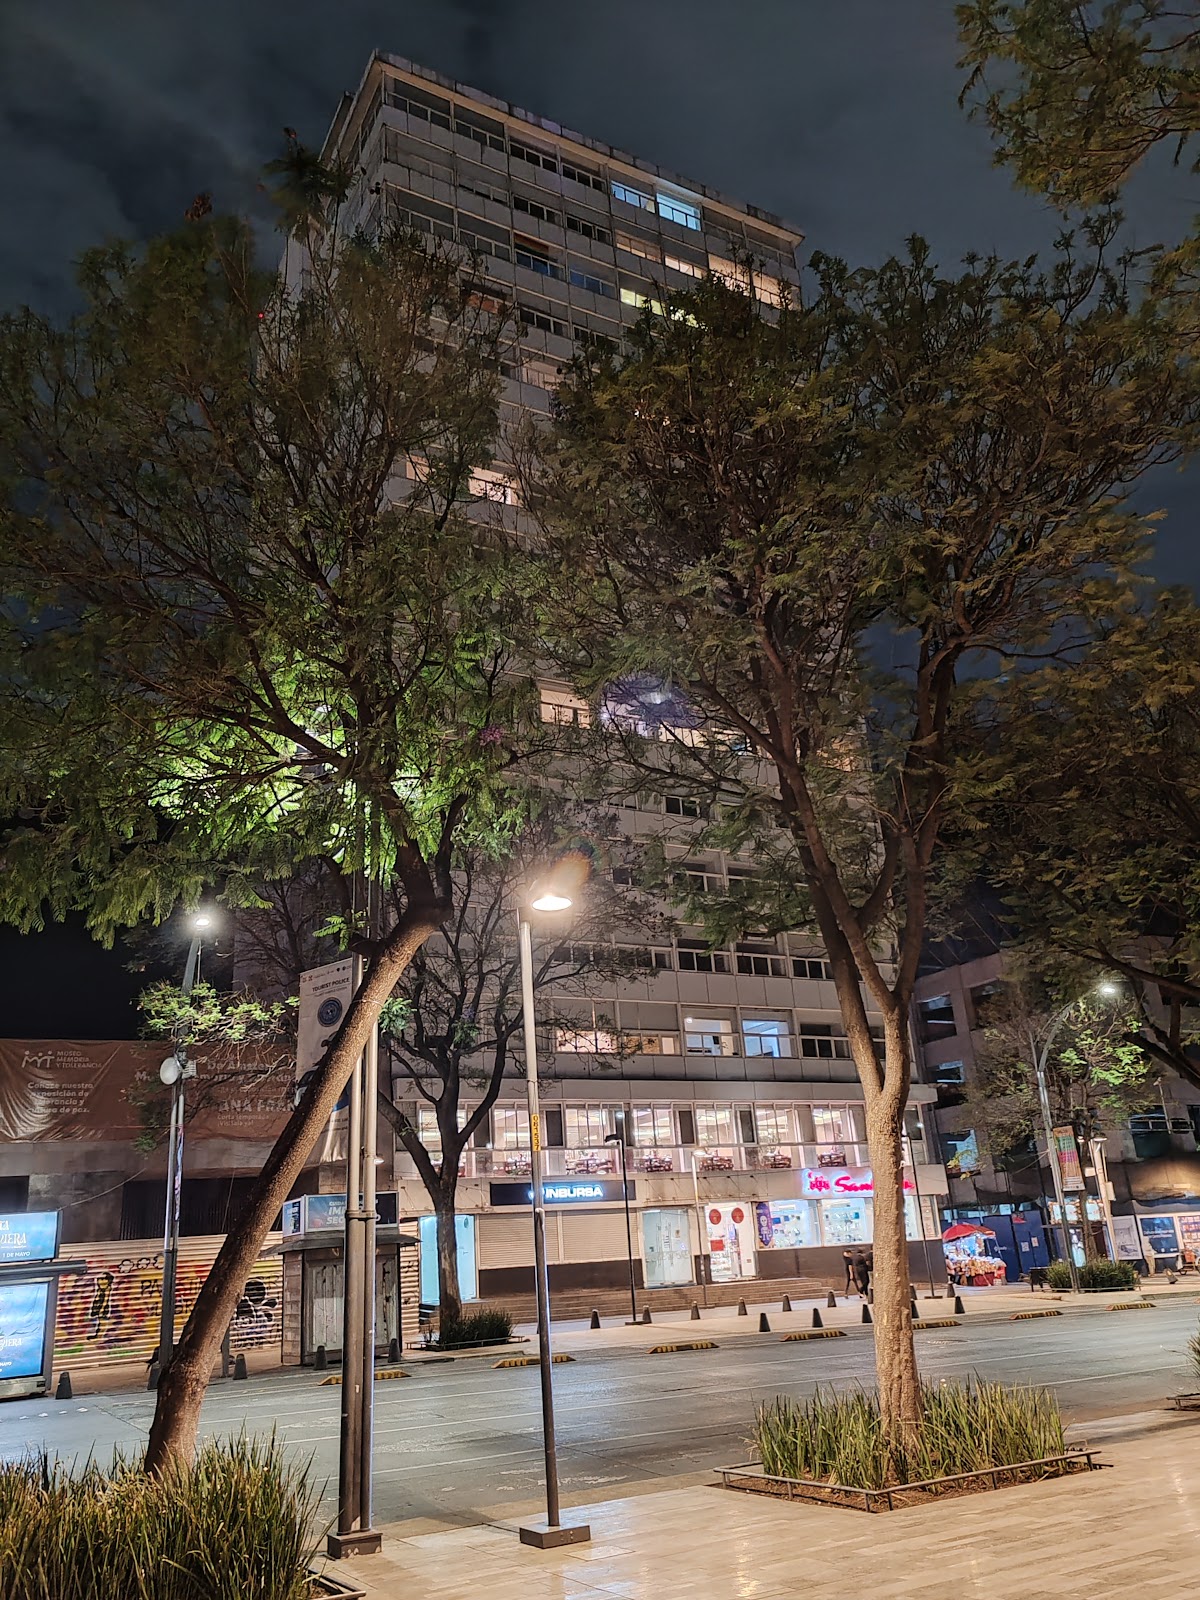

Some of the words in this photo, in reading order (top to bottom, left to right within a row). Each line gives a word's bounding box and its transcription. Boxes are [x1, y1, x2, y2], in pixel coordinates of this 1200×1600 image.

[312, 981, 332, 992] TOURIST
[332, 977, 350, 987] POLICE
[545, 1186, 603, 1199] INBURSA
